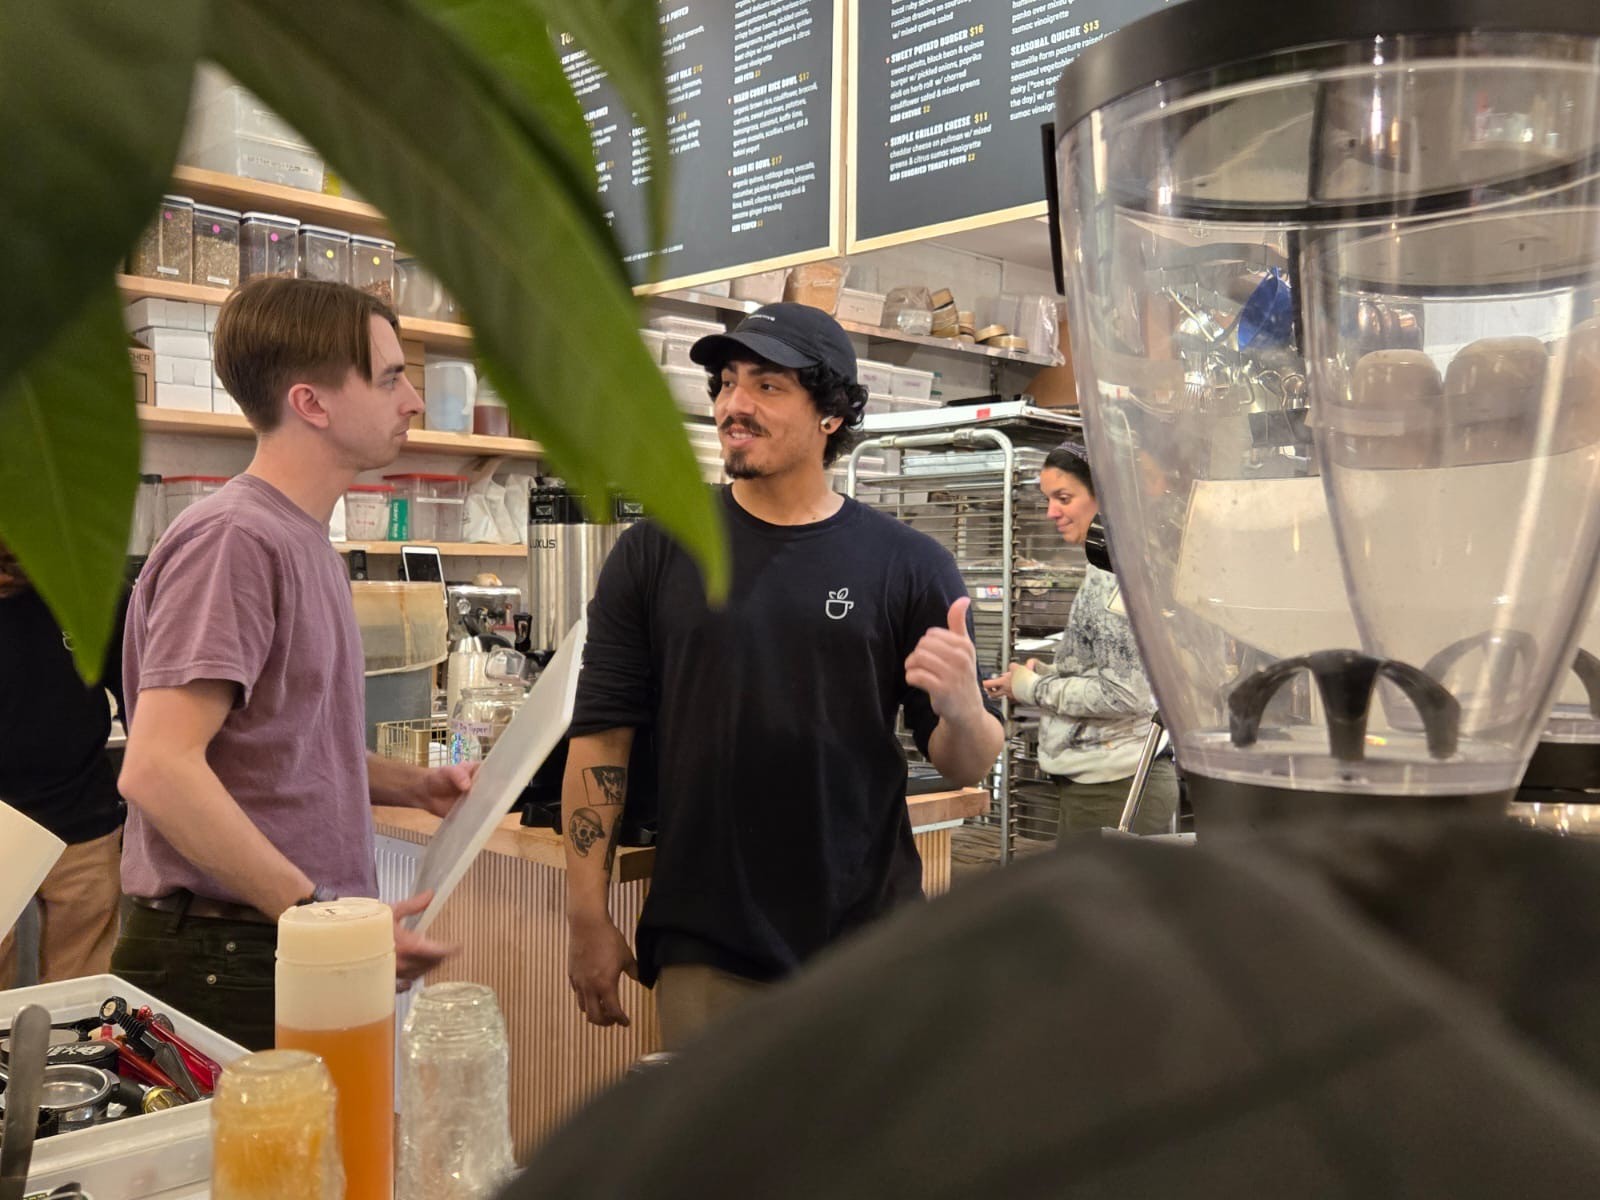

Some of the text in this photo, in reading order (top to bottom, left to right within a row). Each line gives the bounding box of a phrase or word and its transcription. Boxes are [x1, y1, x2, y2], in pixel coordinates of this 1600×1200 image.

[901, 25, 917, 37] mixed
[918, 19, 936, 32] greens
[891, 24, 984, 63] SWEET POTATO BURGER $16
[1011, 36, 1049, 56] SEASONAL
[1051, 26, 1080, 44] QUICHE
[1083, 20, 1100, 34] $13
[927, 52, 942, 63] black
[918, 66, 937, 80] pickled
[959, 53, 982, 67] paprika
[798, 72, 810, 82] $17
[944, 69, 966, 83] charred
[937, 88, 941, 97] &
[942, 83, 959, 95] mixed
[960, 79, 980, 92] greens
[1010, 97, 1021, 108] the
[891, 131, 914, 147] SIMPLE
[915, 123, 943, 139] GRILLED
[944, 116, 970, 131] CHEESE
[964, 129, 973, 138] w/
[973, 124, 992, 136] mixed
[914, 154, 929, 164] citrus
